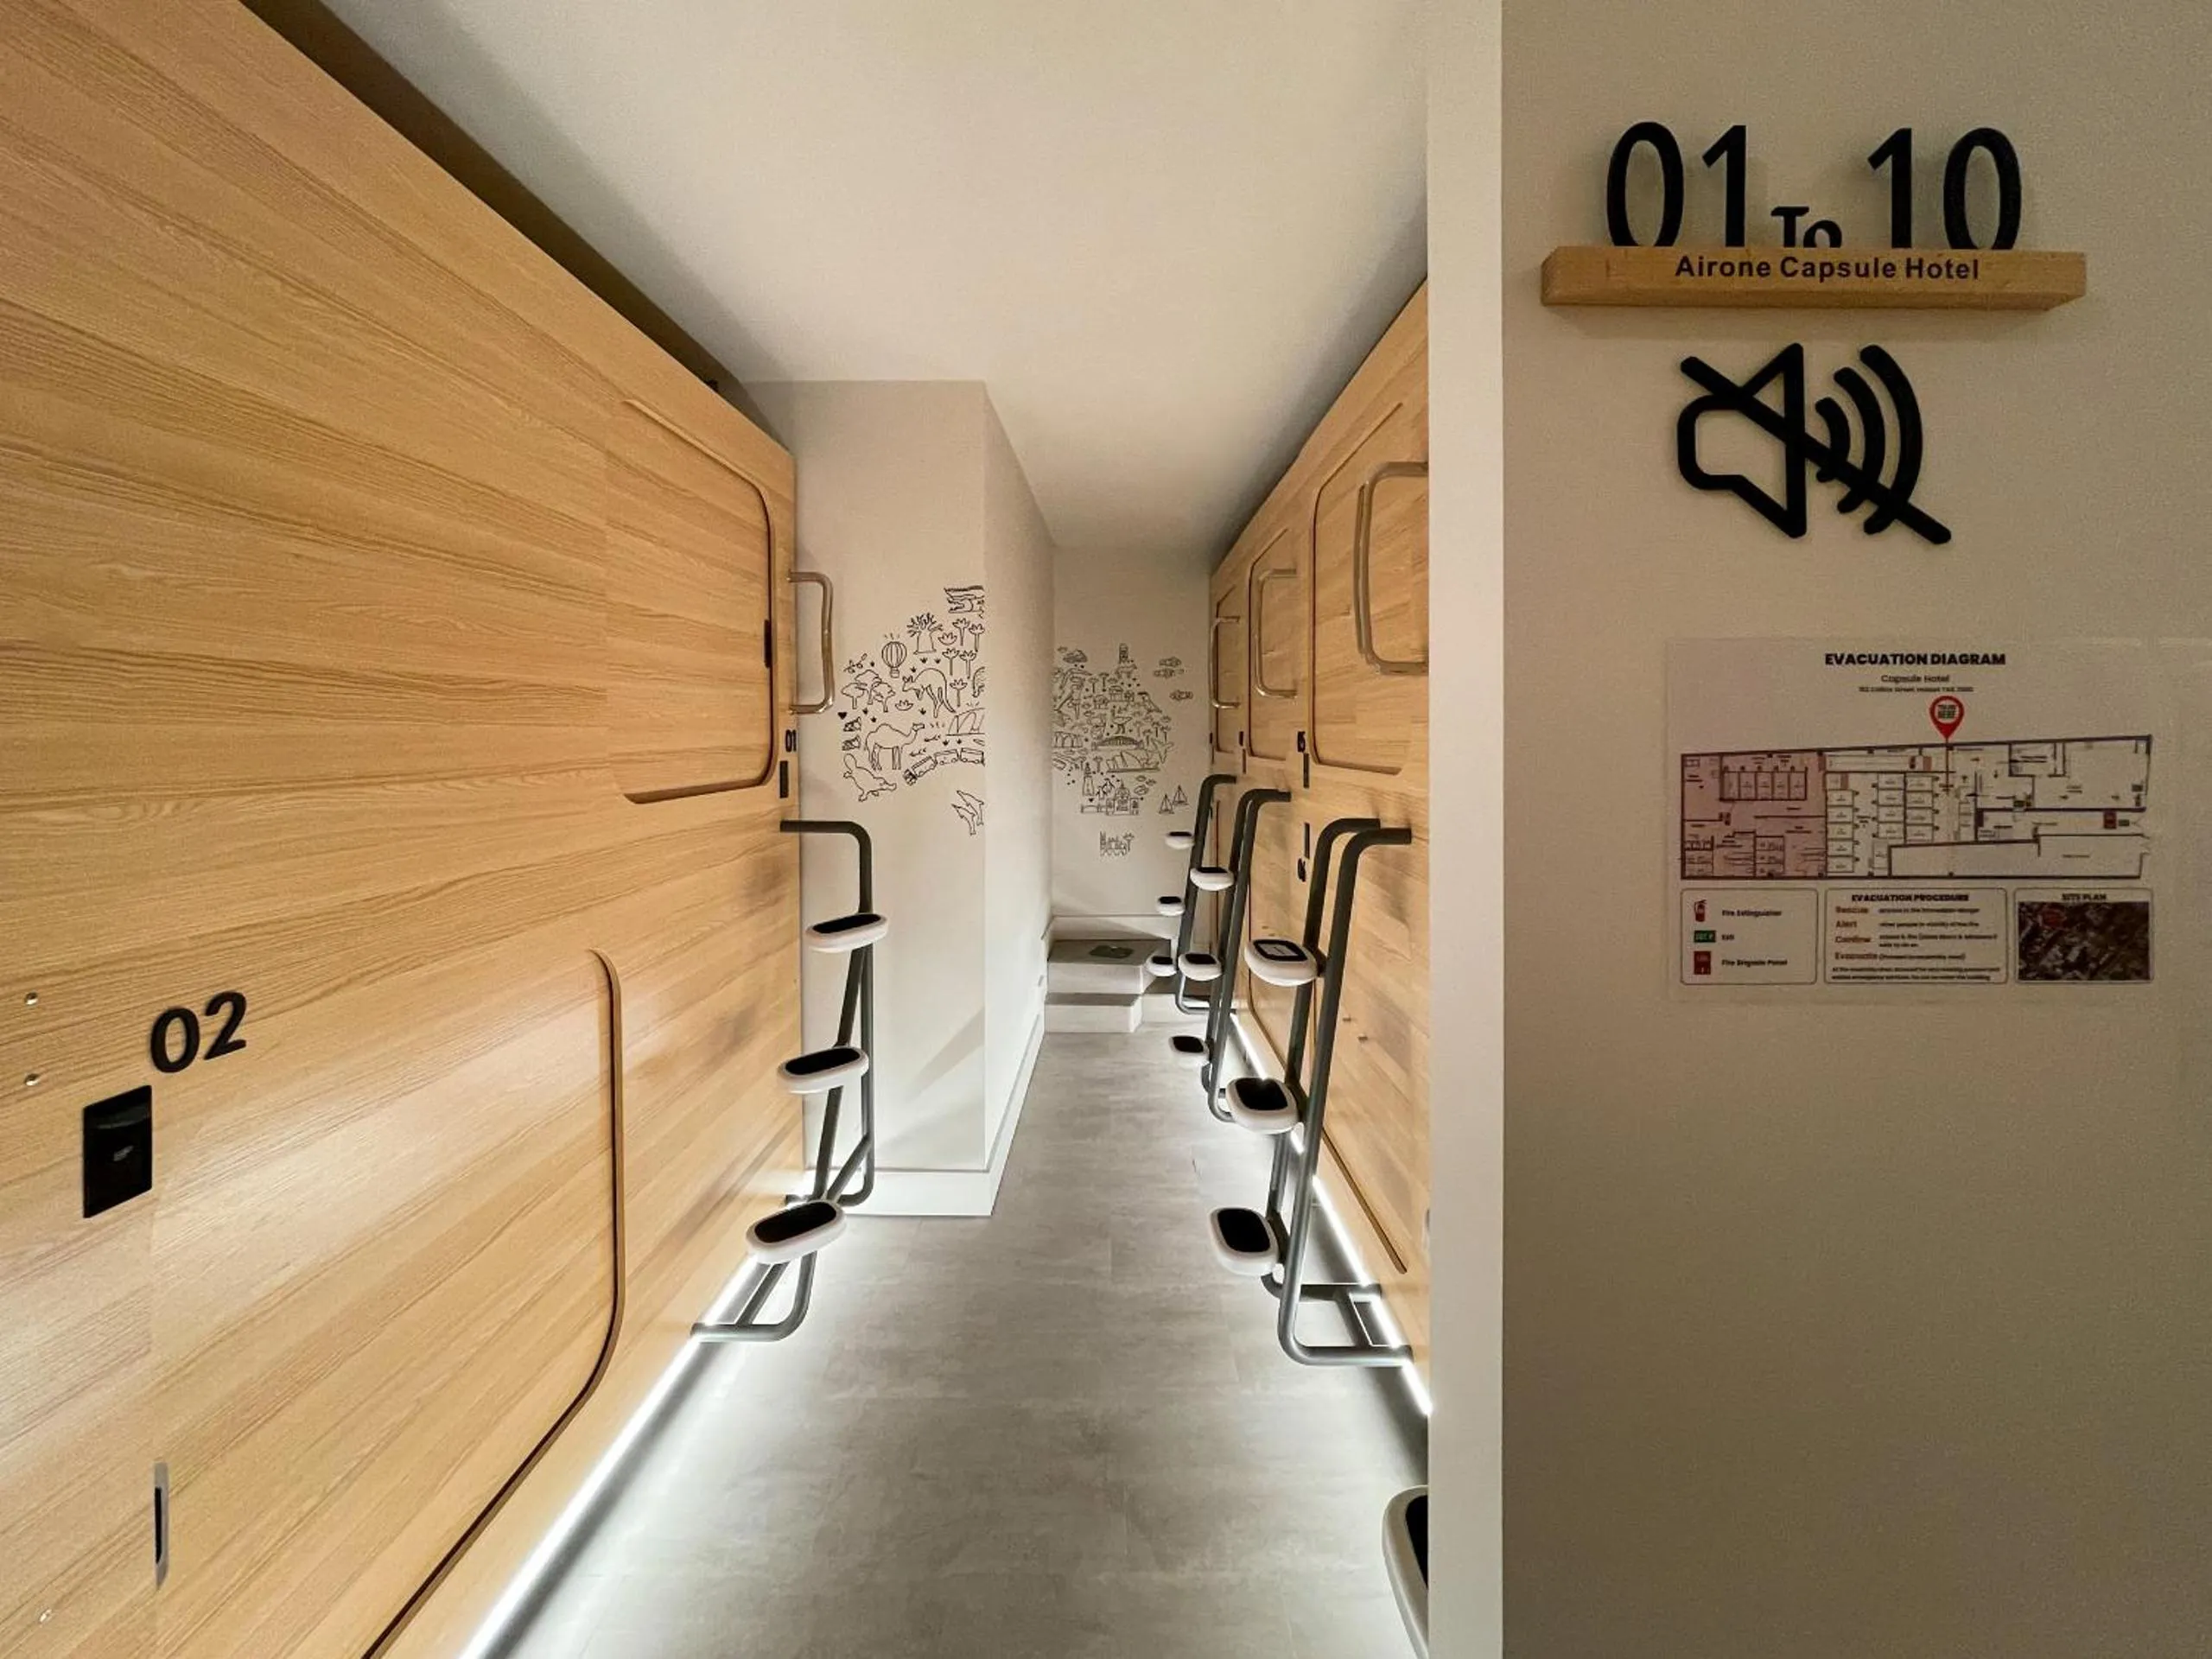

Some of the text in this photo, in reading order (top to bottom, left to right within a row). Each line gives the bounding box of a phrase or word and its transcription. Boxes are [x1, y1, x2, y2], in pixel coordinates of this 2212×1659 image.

[1606, 122, 2022, 250] 01 To 10
[1675, 256, 1980, 283] Airone Capsule Hotel
[1825, 653, 2006, 665] EVACUATION DIAGRAM
[1881, 674, 1950, 683] Capsule Hotel
[150, 991, 247, 1073] 02
